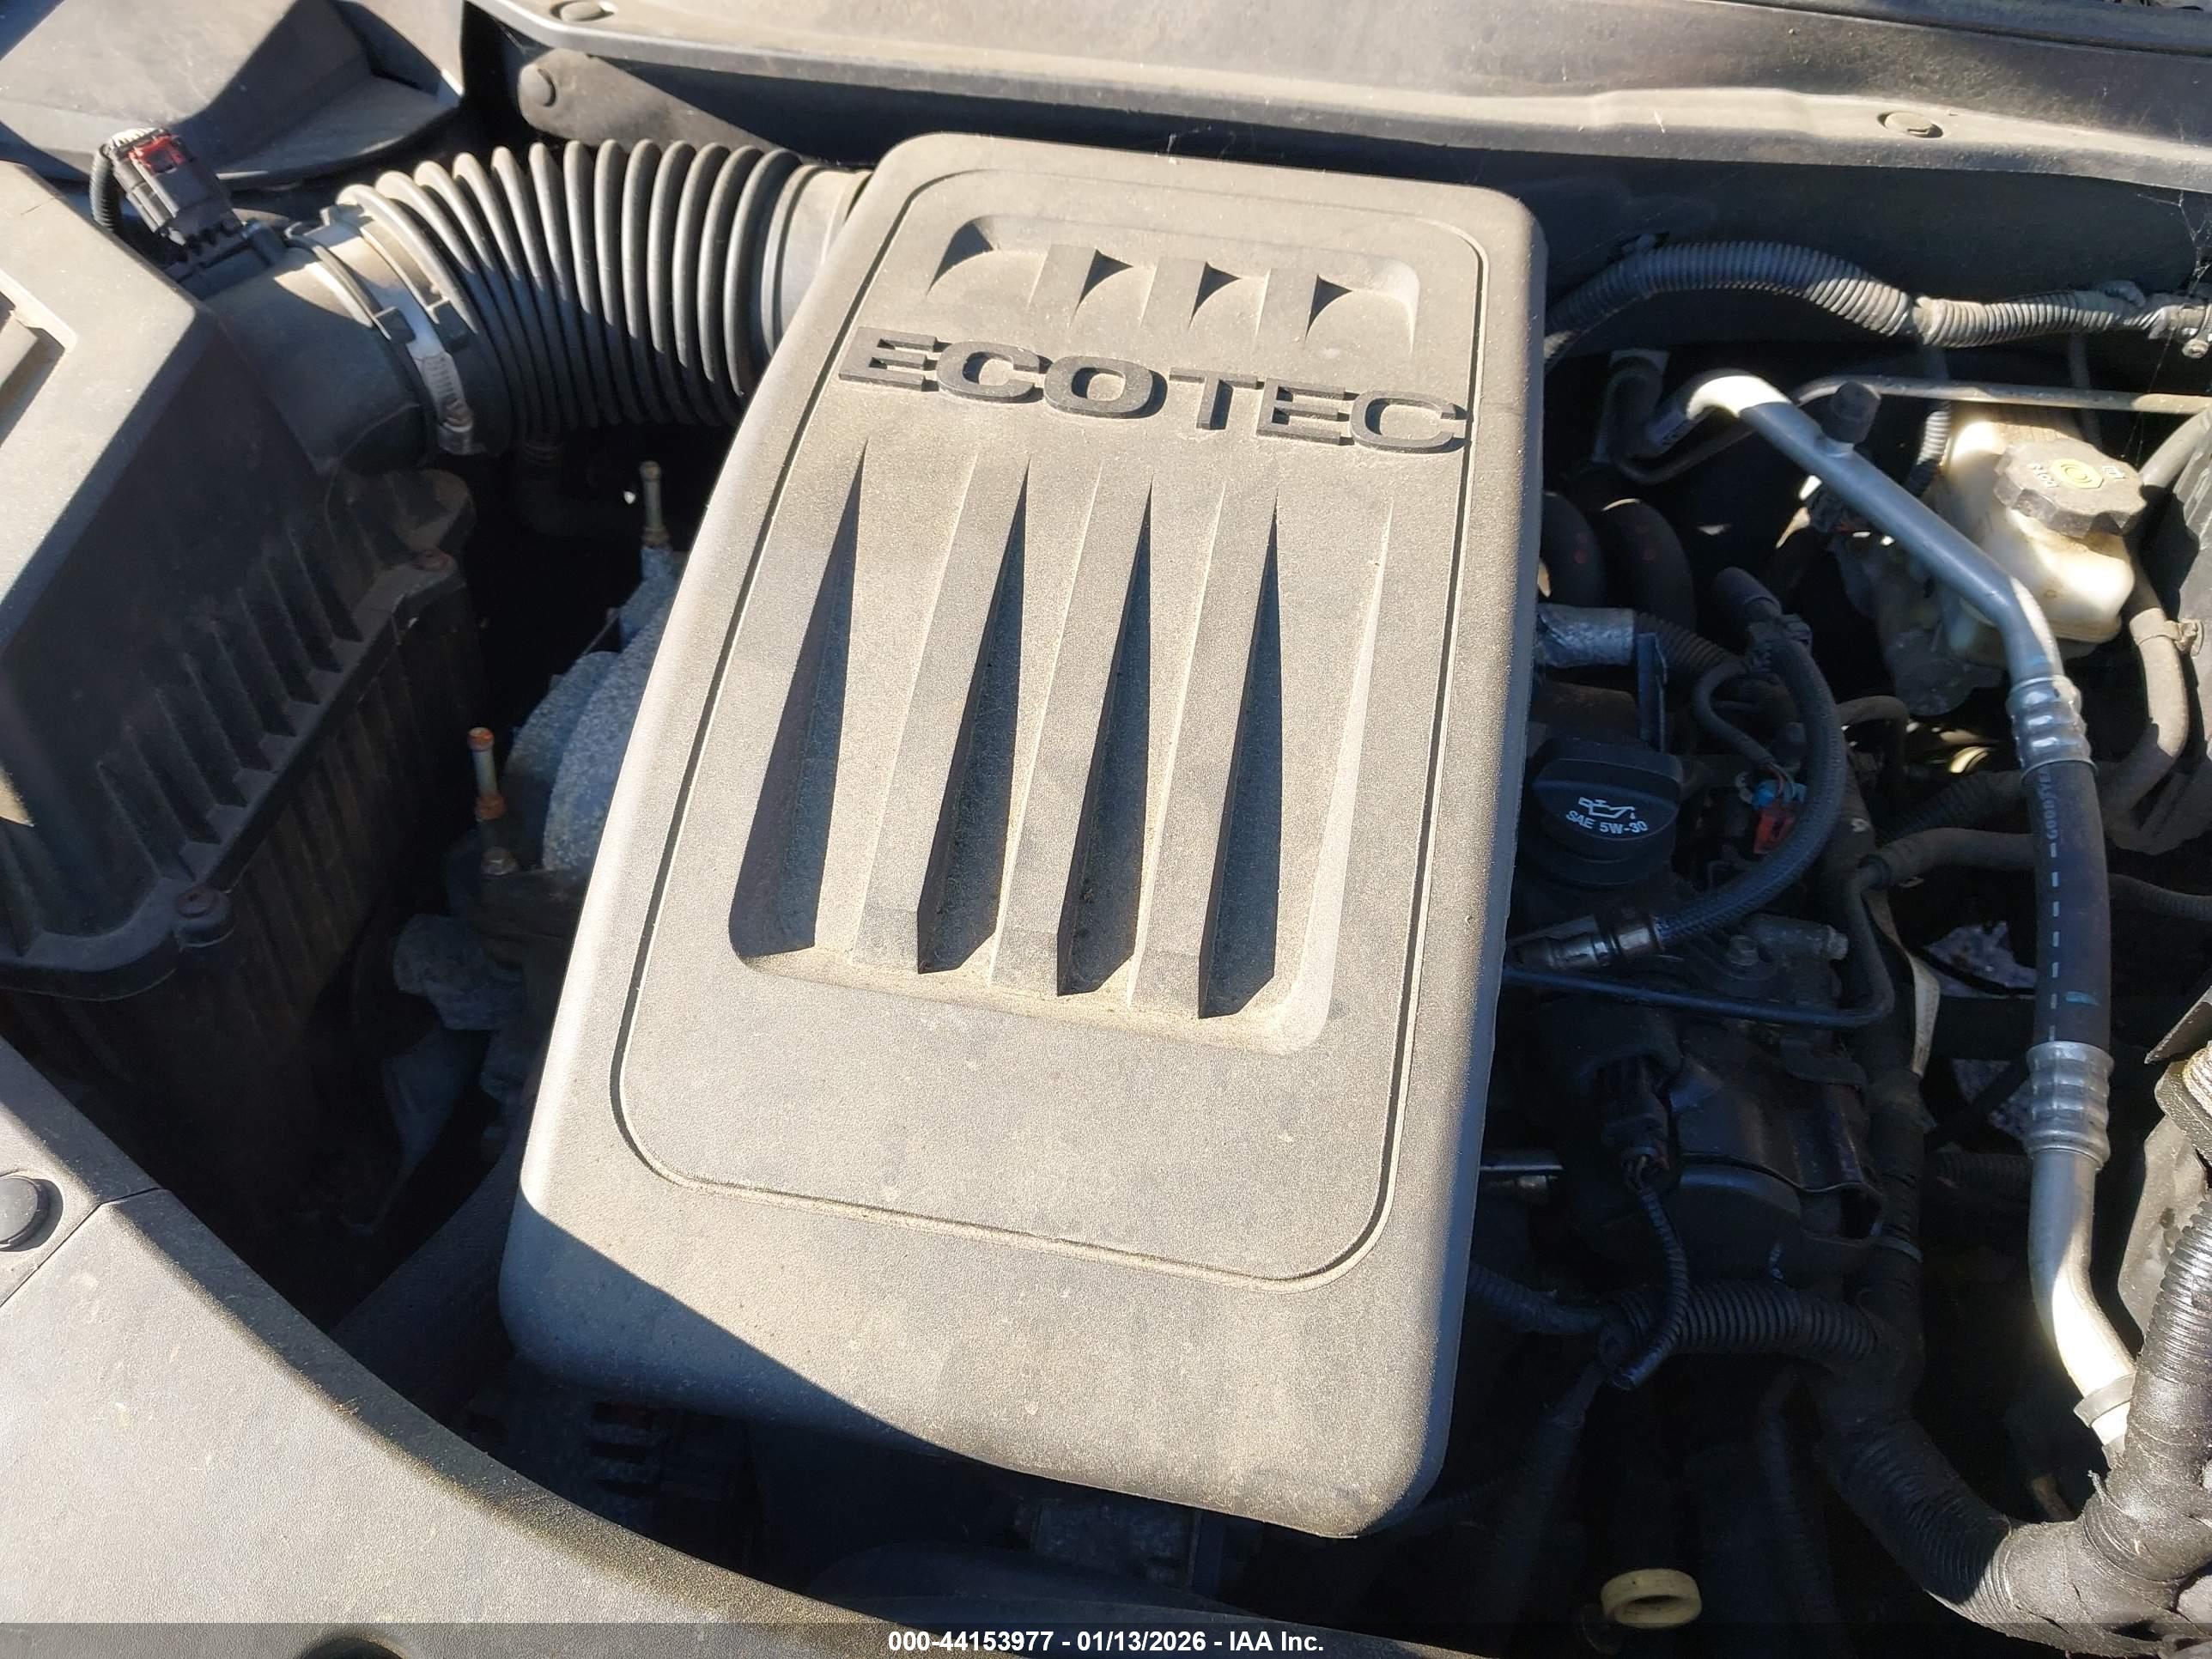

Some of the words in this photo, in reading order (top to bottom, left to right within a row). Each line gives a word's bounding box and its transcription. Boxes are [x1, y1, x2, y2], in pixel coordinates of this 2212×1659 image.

[838, 325, 1468, 455] ECOTEC
[1565, 810, 1595, 830] SAE
[1599, 820, 1649, 835] 5W-30
